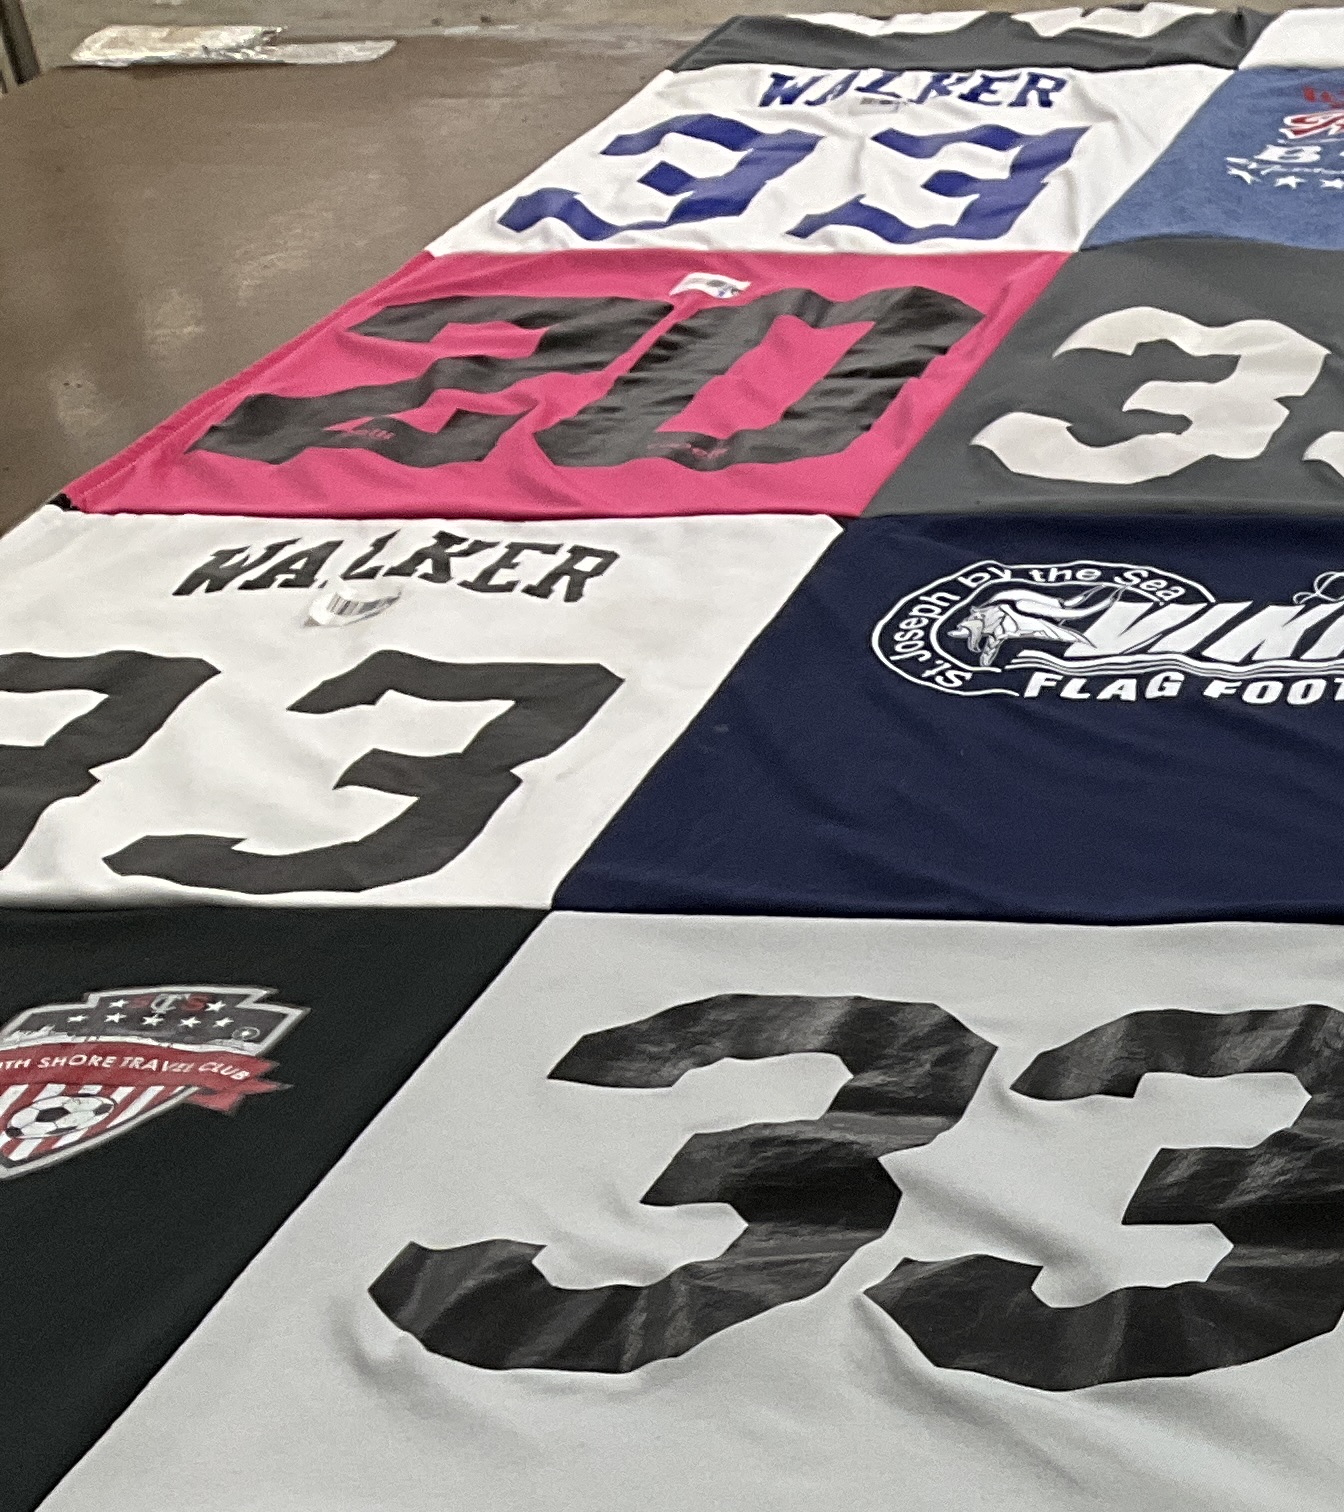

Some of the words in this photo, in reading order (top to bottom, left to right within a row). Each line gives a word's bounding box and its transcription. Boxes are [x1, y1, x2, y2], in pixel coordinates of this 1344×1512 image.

[758, 70, 1069, 108] WALKER
[498, 113, 1092, 243] 33
[185, 285, 987, 471] 20
[172, 528, 621, 603] WALKER
[889, 591, 962, 662] Joseph
[957, 566, 1012, 589] by
[1029, 567, 1102, 583] the
[1113, 569, 1186, 603] Sea
[1023, 671, 1184, 701] FLAG
[37, 1054, 117, 1069] SHORE
[198, 1061, 251, 1081] CLUB
